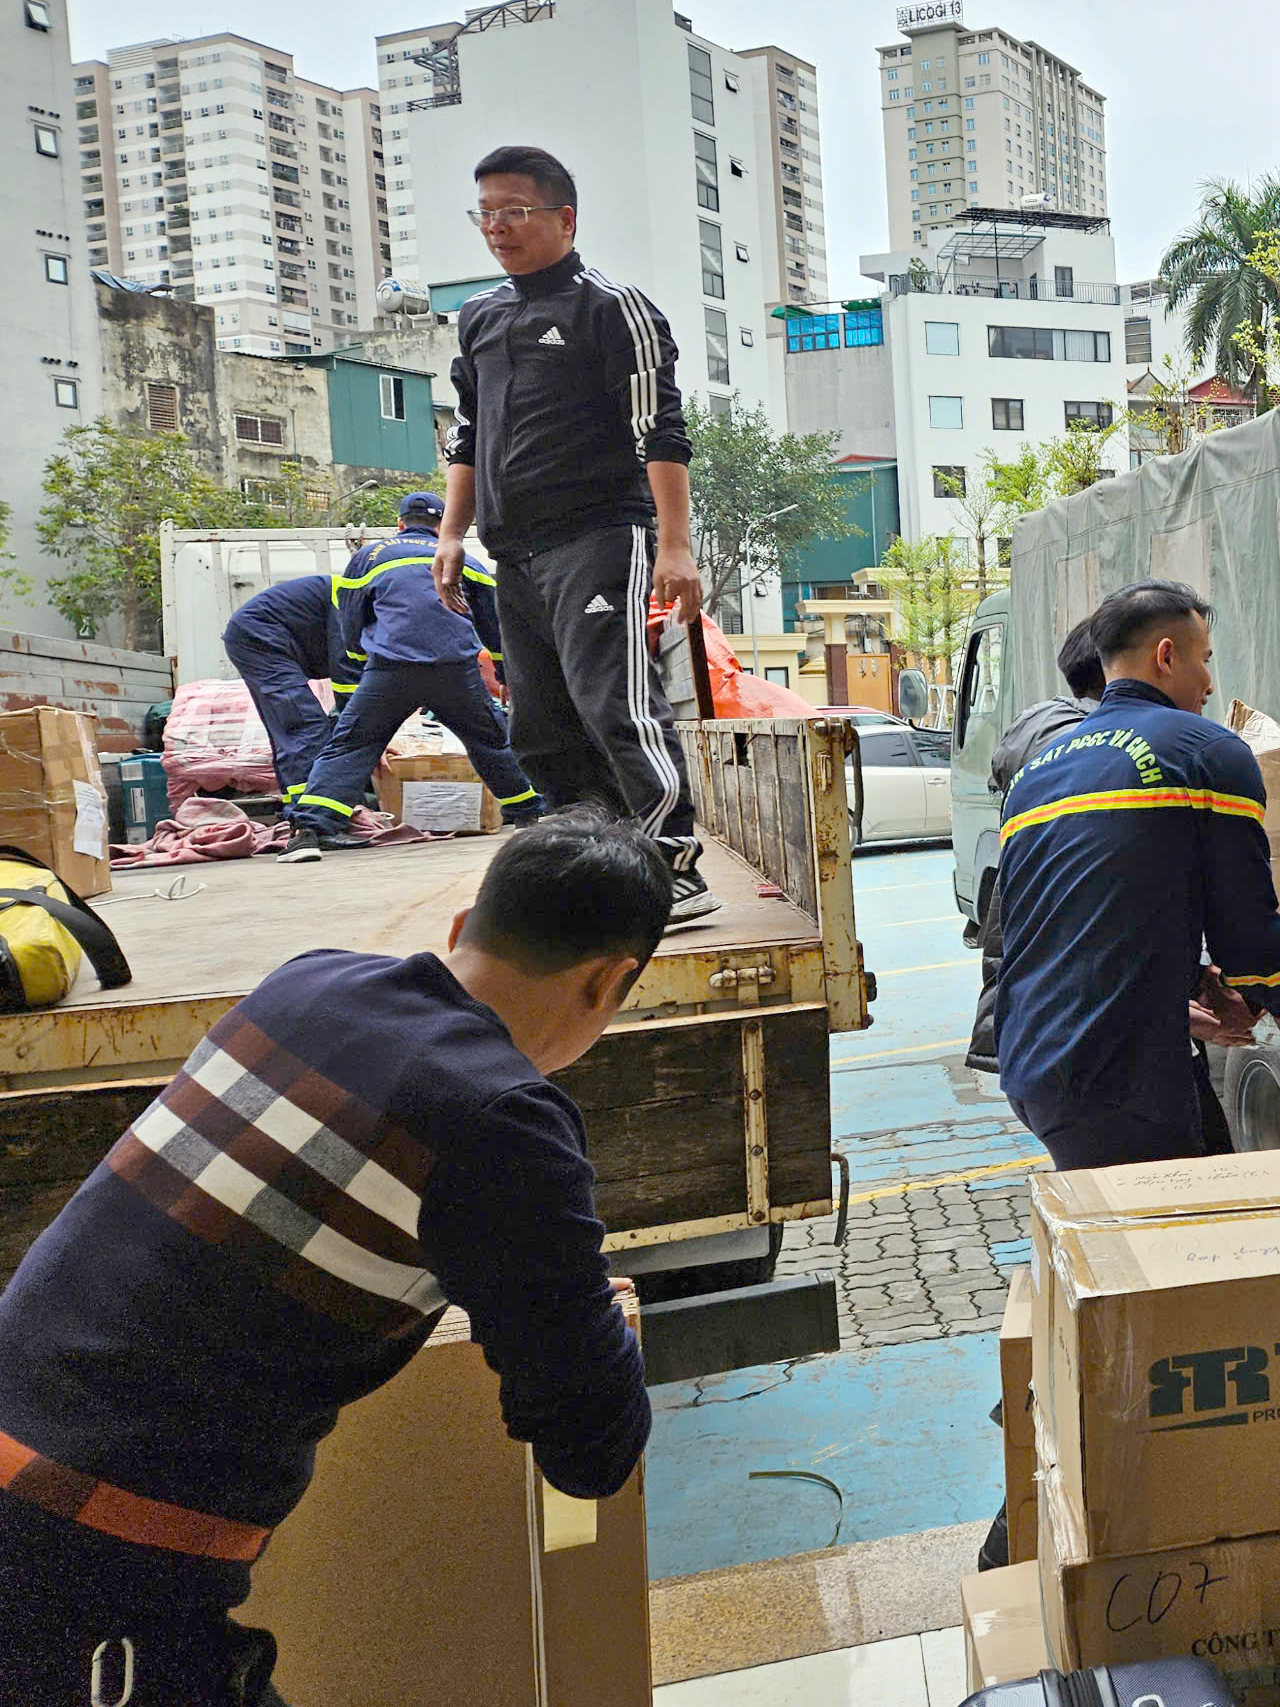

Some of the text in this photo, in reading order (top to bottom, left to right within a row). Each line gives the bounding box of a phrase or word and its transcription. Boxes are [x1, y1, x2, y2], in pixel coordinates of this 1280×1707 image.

[909, 1, 961, 22] LICOGI 13
[584, 604, 614, 614] adidas
[1125, 736, 1163, 785] CNCH
[1191, 1631, 1257, 1658] CÔNG
